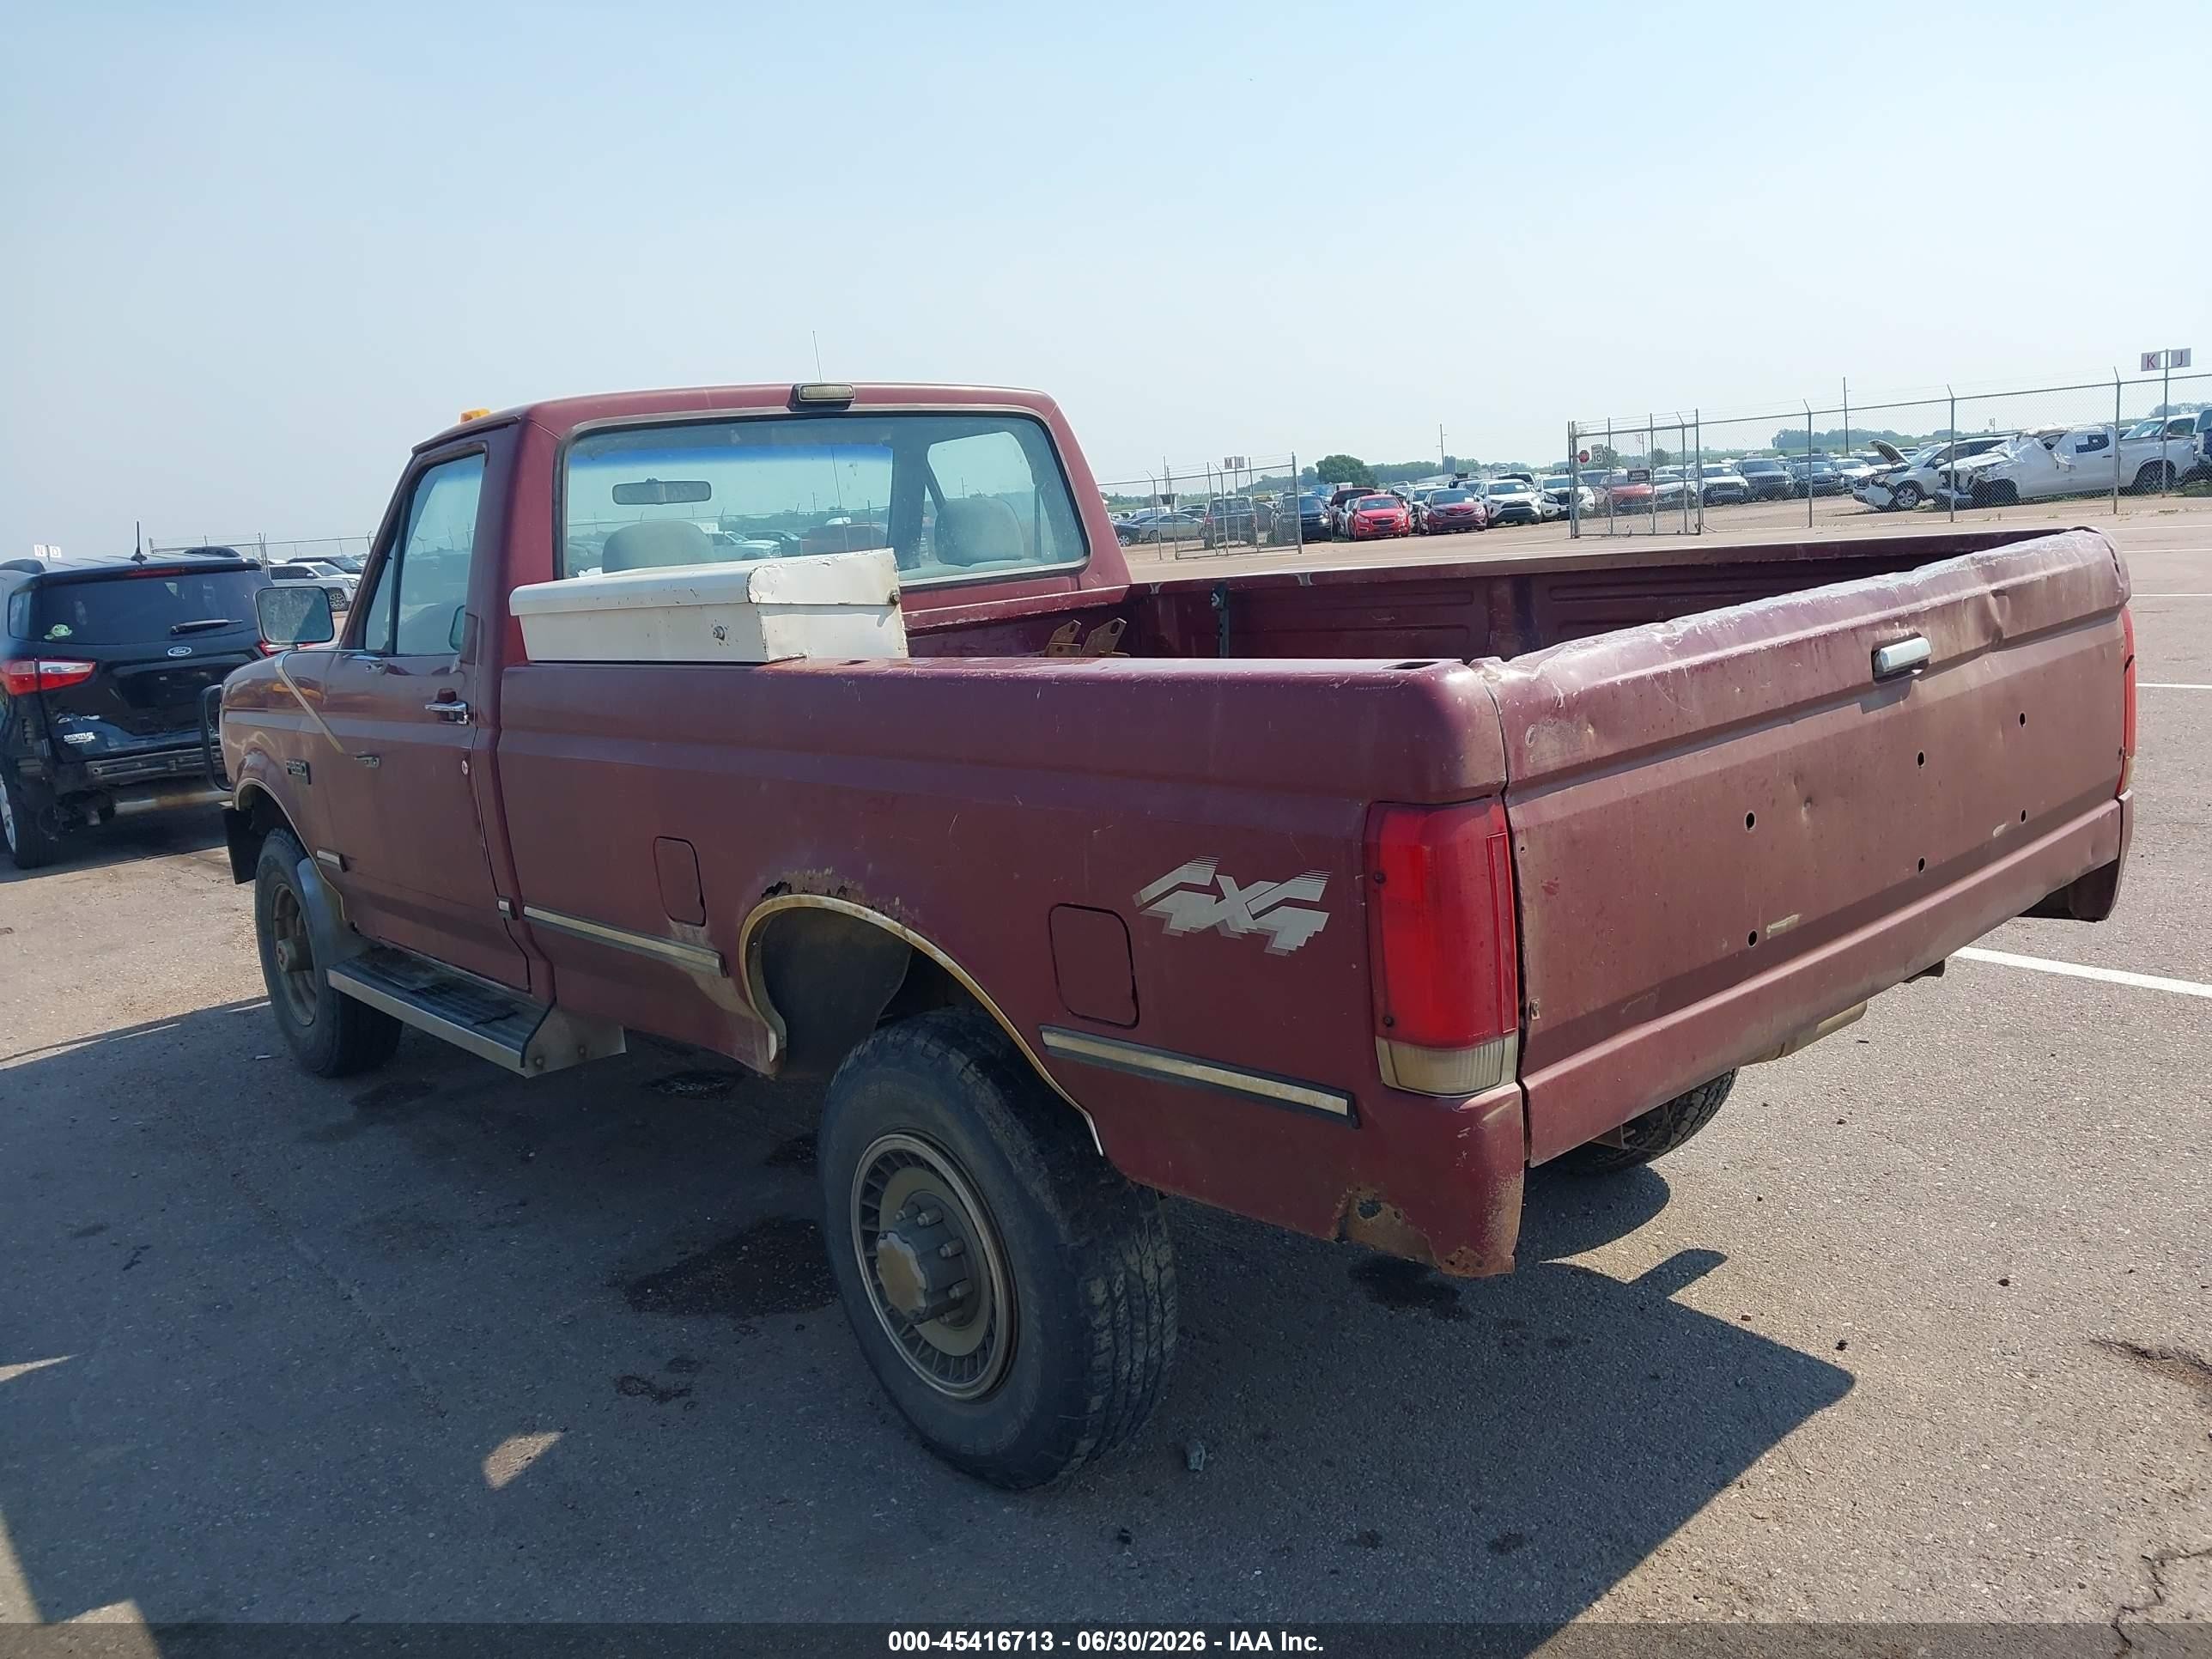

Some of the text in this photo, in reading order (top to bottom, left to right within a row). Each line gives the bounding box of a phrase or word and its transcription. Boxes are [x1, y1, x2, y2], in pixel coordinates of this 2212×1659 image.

[2146, 350, 2184, 369] K J
[1224, 458, 1232, 469] M
[1593, 453, 1602, 463] 10
